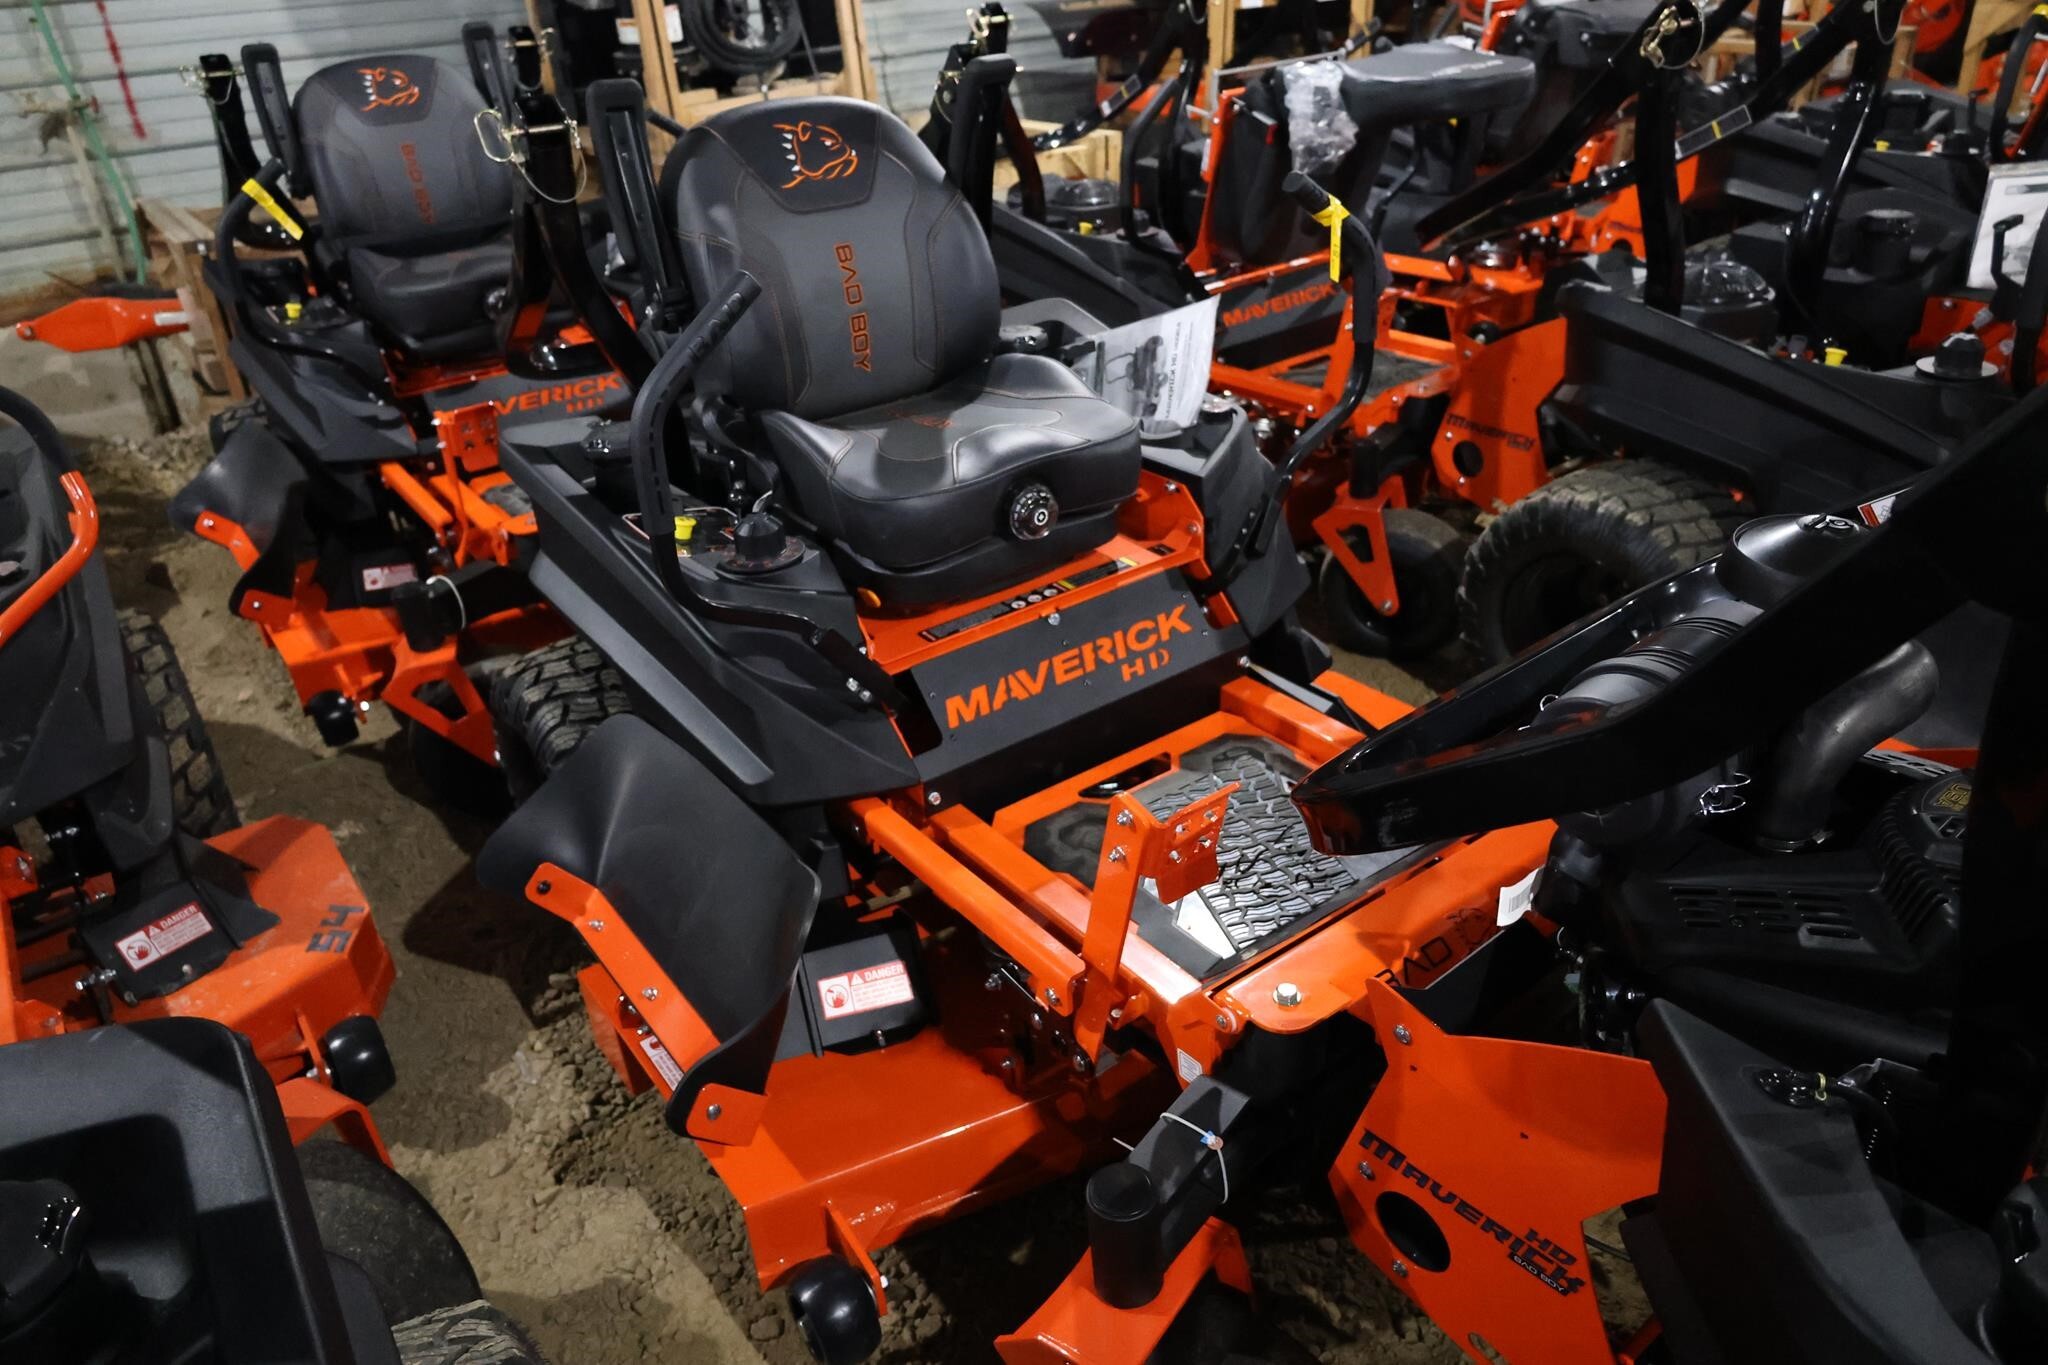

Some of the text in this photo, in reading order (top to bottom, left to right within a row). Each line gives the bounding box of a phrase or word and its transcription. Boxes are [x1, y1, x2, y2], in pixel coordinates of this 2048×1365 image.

[834, 243, 872, 372] BAD BOY
[1222, 282, 1338, 328] MAVERICK
[494, 373, 622, 416] VERICK
[944, 604, 1192, 729] MAVERICK
[1121, 648, 1171, 682] HD
[160, 905, 198, 930] DANGER
[864, 964, 904, 982] DANGER
[1359, 1128, 1585, 1294] MAVERICK
[1525, 1227, 1577, 1265] HD
[1513, 1254, 1565, 1292] BAD BOY
